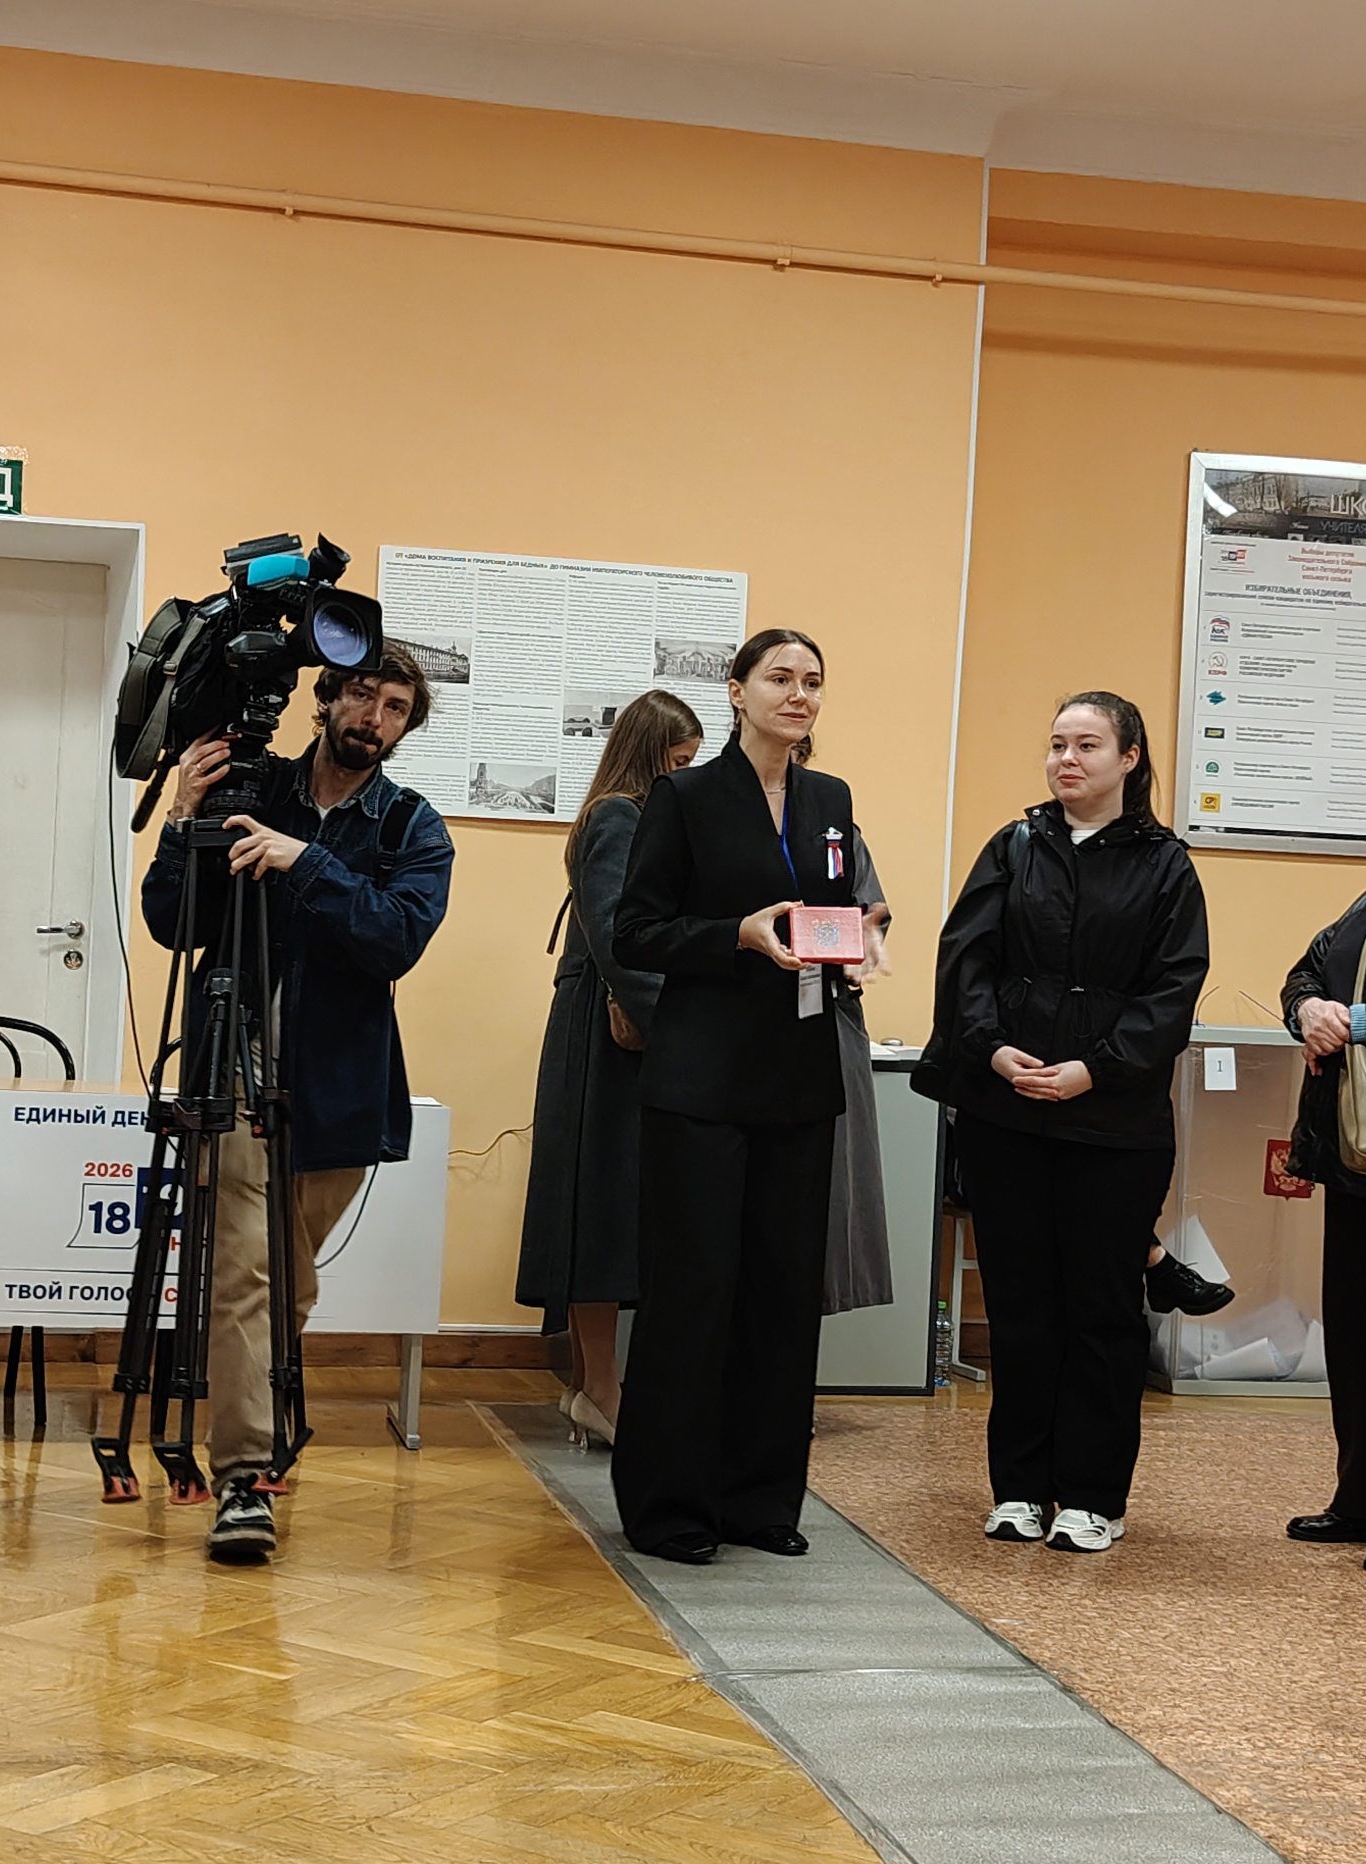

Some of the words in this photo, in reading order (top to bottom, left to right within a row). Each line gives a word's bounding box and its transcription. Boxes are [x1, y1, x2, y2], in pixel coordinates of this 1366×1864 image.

[14, 1105, 106, 1126] ЕДИНЫЙ
[84, 1162, 134, 1178] 2026
[88, 1201, 131, 1235] 18
[4, 1280, 63, 1300] ТВОЙ
